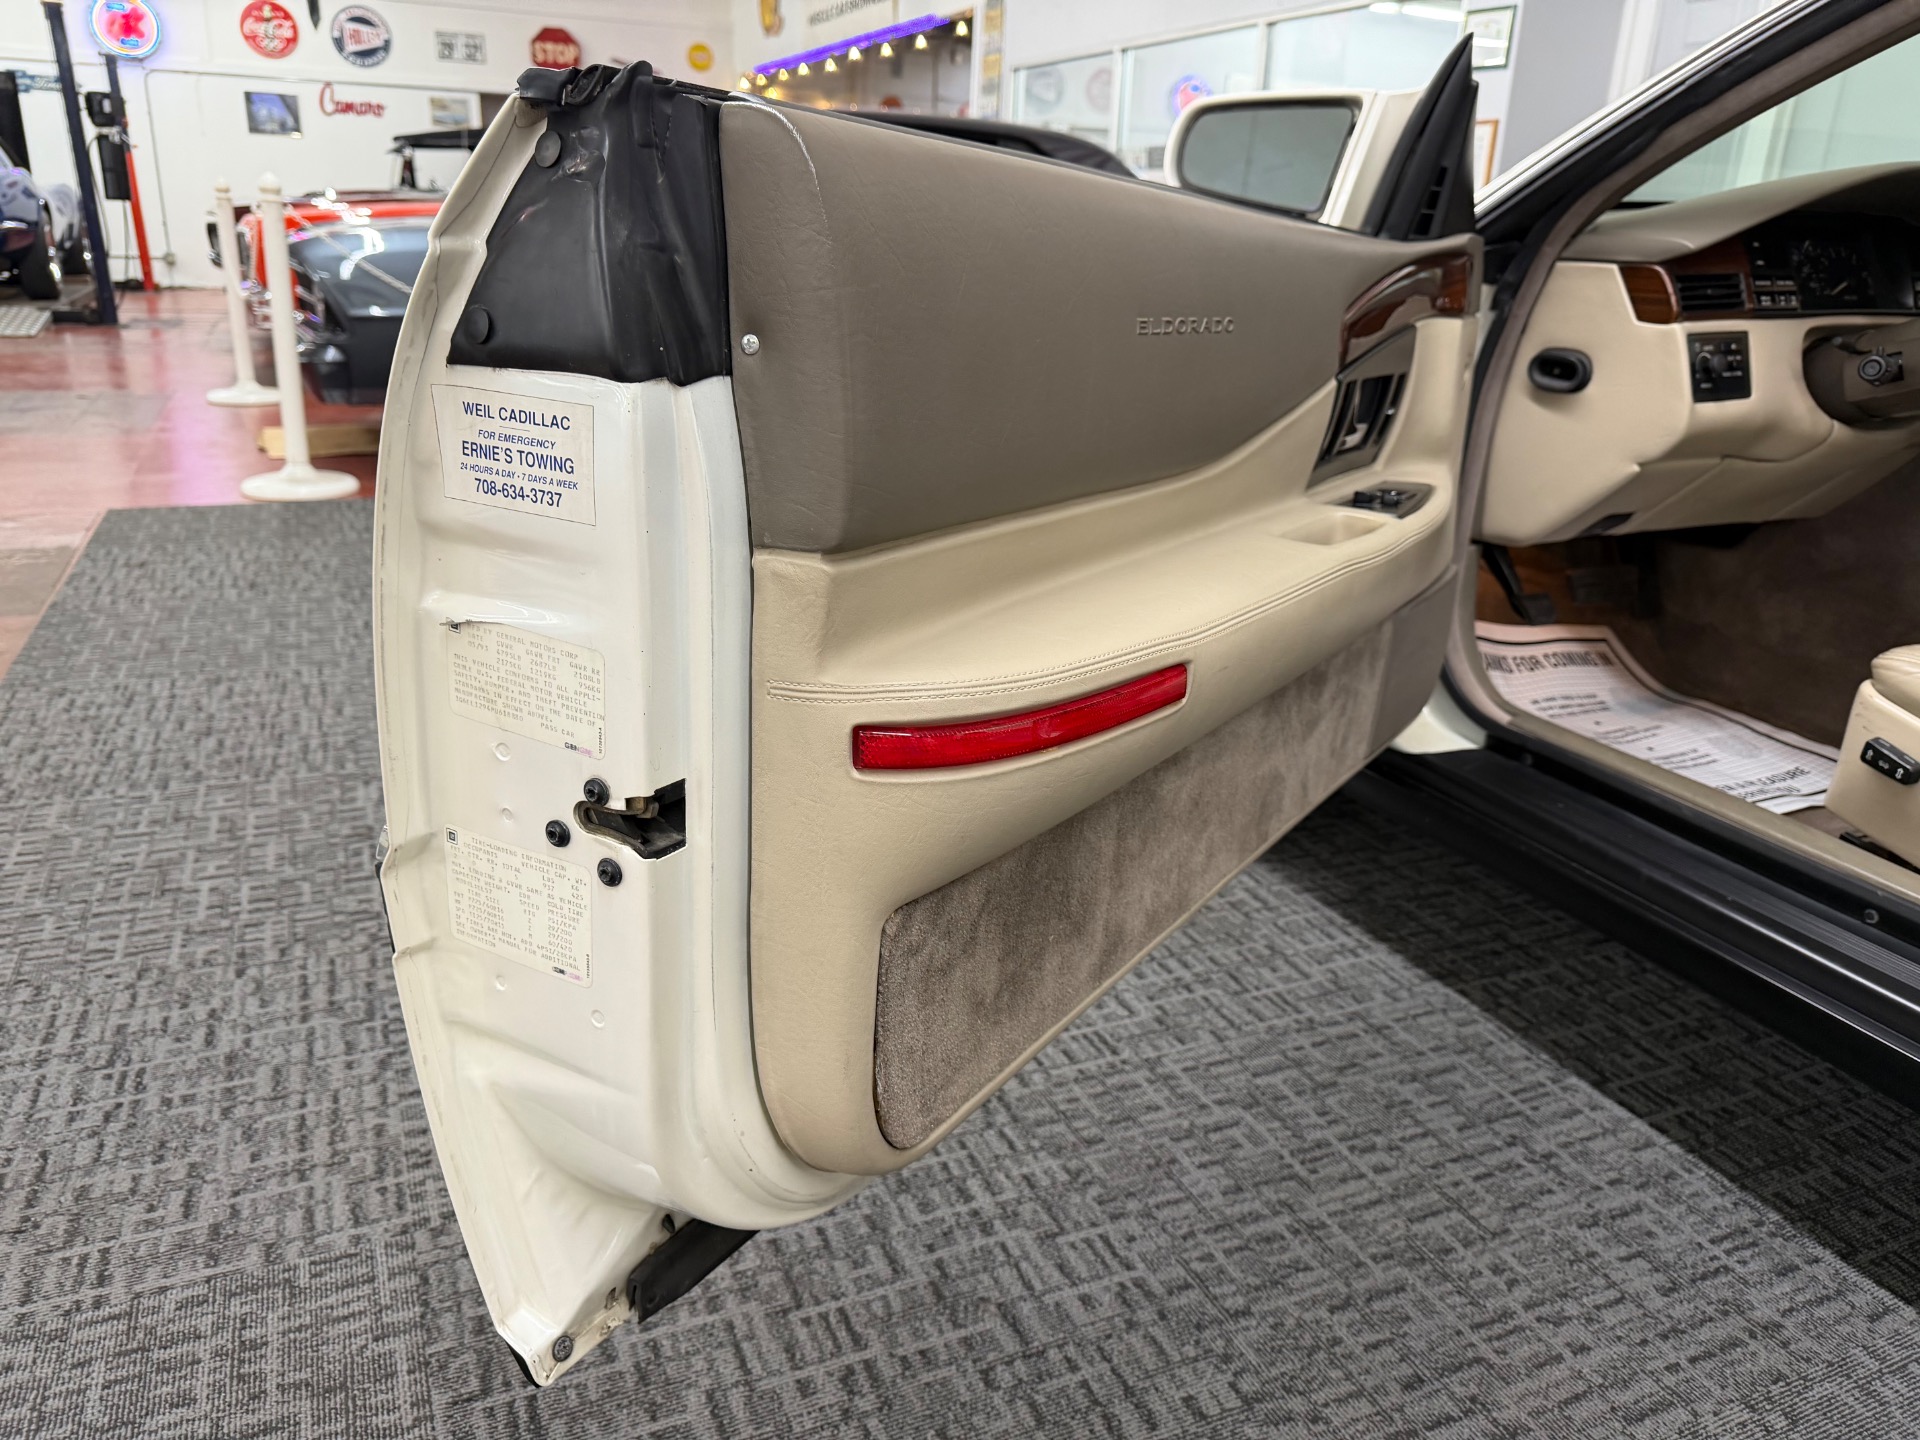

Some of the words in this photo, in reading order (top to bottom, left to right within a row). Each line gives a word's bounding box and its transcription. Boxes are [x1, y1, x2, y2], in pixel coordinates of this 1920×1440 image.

[532, 41, 578, 65] STOP
[1136, 317, 1234, 336] ELDORADO
[462, 401, 495, 419] WEIL
[499, 407, 571, 430] CADILLAC
[478, 430, 496, 440] FOR
[498, 433, 556, 450] EMERGENCY
[462, 440, 513, 464] ERNIE'S
[516, 450, 574, 475] TOWING
[460, 462, 468, 471] 24
[469, 464, 493, 475] HOURS
[502, 470, 516, 479] DAY
[522, 473, 526, 481] 7
[528, 474, 547, 485] DAYS
[549, 478, 554, 486] A
[556, 479, 579, 490] WEEK
[474, 478, 562, 507] 708-634-3737
[496, 649, 521, 662] 4795LB
[497, 632, 526, 646] GENERAL
[530, 641, 556, 654] MOTORS
[561, 649, 578, 660] CORP
[497, 640, 514, 651] GVWR
[526, 648, 543, 659] GAWR
[548, 655, 560, 664] FRT
[569, 661, 587, 672] GAWR
[591, 667, 601, 676] RR
[454, 653, 468, 663] THIS
[473, 659, 500, 673] VEHICLE
[505, 669, 539, 685] CONFORMS
[544, 680, 553, 689] TO
[556, 684, 569, 694] ALL
[574, 689, 601, 704] APPLI-
[1511, 655, 1545, 673] FOR
[453, 661, 472, 673] CABLE
[477, 669, 493, 679] U.S.
[498, 675, 526, 689] FEDERAL
[530, 685, 552, 697] MOTOR
[557, 693, 587, 708] VEHICLE
[530, 667, 556, 681] 1219KG
[578, 681, 601, 694] 956KG
[455, 679, 490, 695] STANDARDS
[494, 690, 502, 699] IN
[506, 694, 531, 708] EFFECT
[536, 703, 544, 712] ON
[549, 707, 561, 717] THE
[566, 712, 583, 724] DATE
[587, 719, 595, 728] OF
[455, 686, 498, 705] MANUFACTURE
[502, 701, 523, 714] SHOWN
[528, 709, 553, 723] ABOVE.
[518, 689, 531, 699] AND
[536, 695, 556, 707] THEFT
[561, 702, 605, 722] PREVENTION
[541, 722, 557, 733] PASS
[561, 729, 575, 739] CAR
[464, 842, 498, 858] OCCUPANTS
[522, 861, 550, 875] VEHICLE
[554, 871, 570, 882] CAP.
[472, 837, 517, 857] TIRE-LOADING
[522, 853, 567, 873] INFORMATION
[469, 867, 496, 881] LOADING
[507, 879, 523, 890] GVWR
[526, 886, 543, 896] SAME
[547, 892, 555, 900] AS
[559, 896, 588, 911] VEHICLE
[502, 862, 521, 874] TOTAL
[542, 875, 554, 884] LBS
[571, 884, 579, 893] KG
[542, 882, 554, 892] 937
[571, 892, 583, 902] 425
[452, 869, 480, 884] CAPACITY
[548, 901, 563, 911] COLD
[568, 907, 583, 918] TIRE
[468, 889, 481, 899] TIRE
[485, 895, 500, 905] SIZE
[524, 908, 536, 917] RTG
[548, 916, 577, 931] PSI/KPA
[519, 899, 539, 911] SPEED
[548, 908, 580, 925] PRESSURE
[456, 929, 496, 949] INFORMATION
[466, 917, 484, 929] TIRES
[488, 925, 498, 934] ARE
[520, 937, 533, 947] ADD
[537, 943, 577, 963] 4PSI/28KPA
[548, 924, 572, 938] 29/200
[548, 932, 572, 946] 29/200
[456, 921, 465, 930] SEE
[470, 926, 496, 941] OWNER'S
[499, 936, 521, 950] MANUAL
[525, 946, 537, 956] FOR
[541, 952, 580, 971] ADDITIONAL
